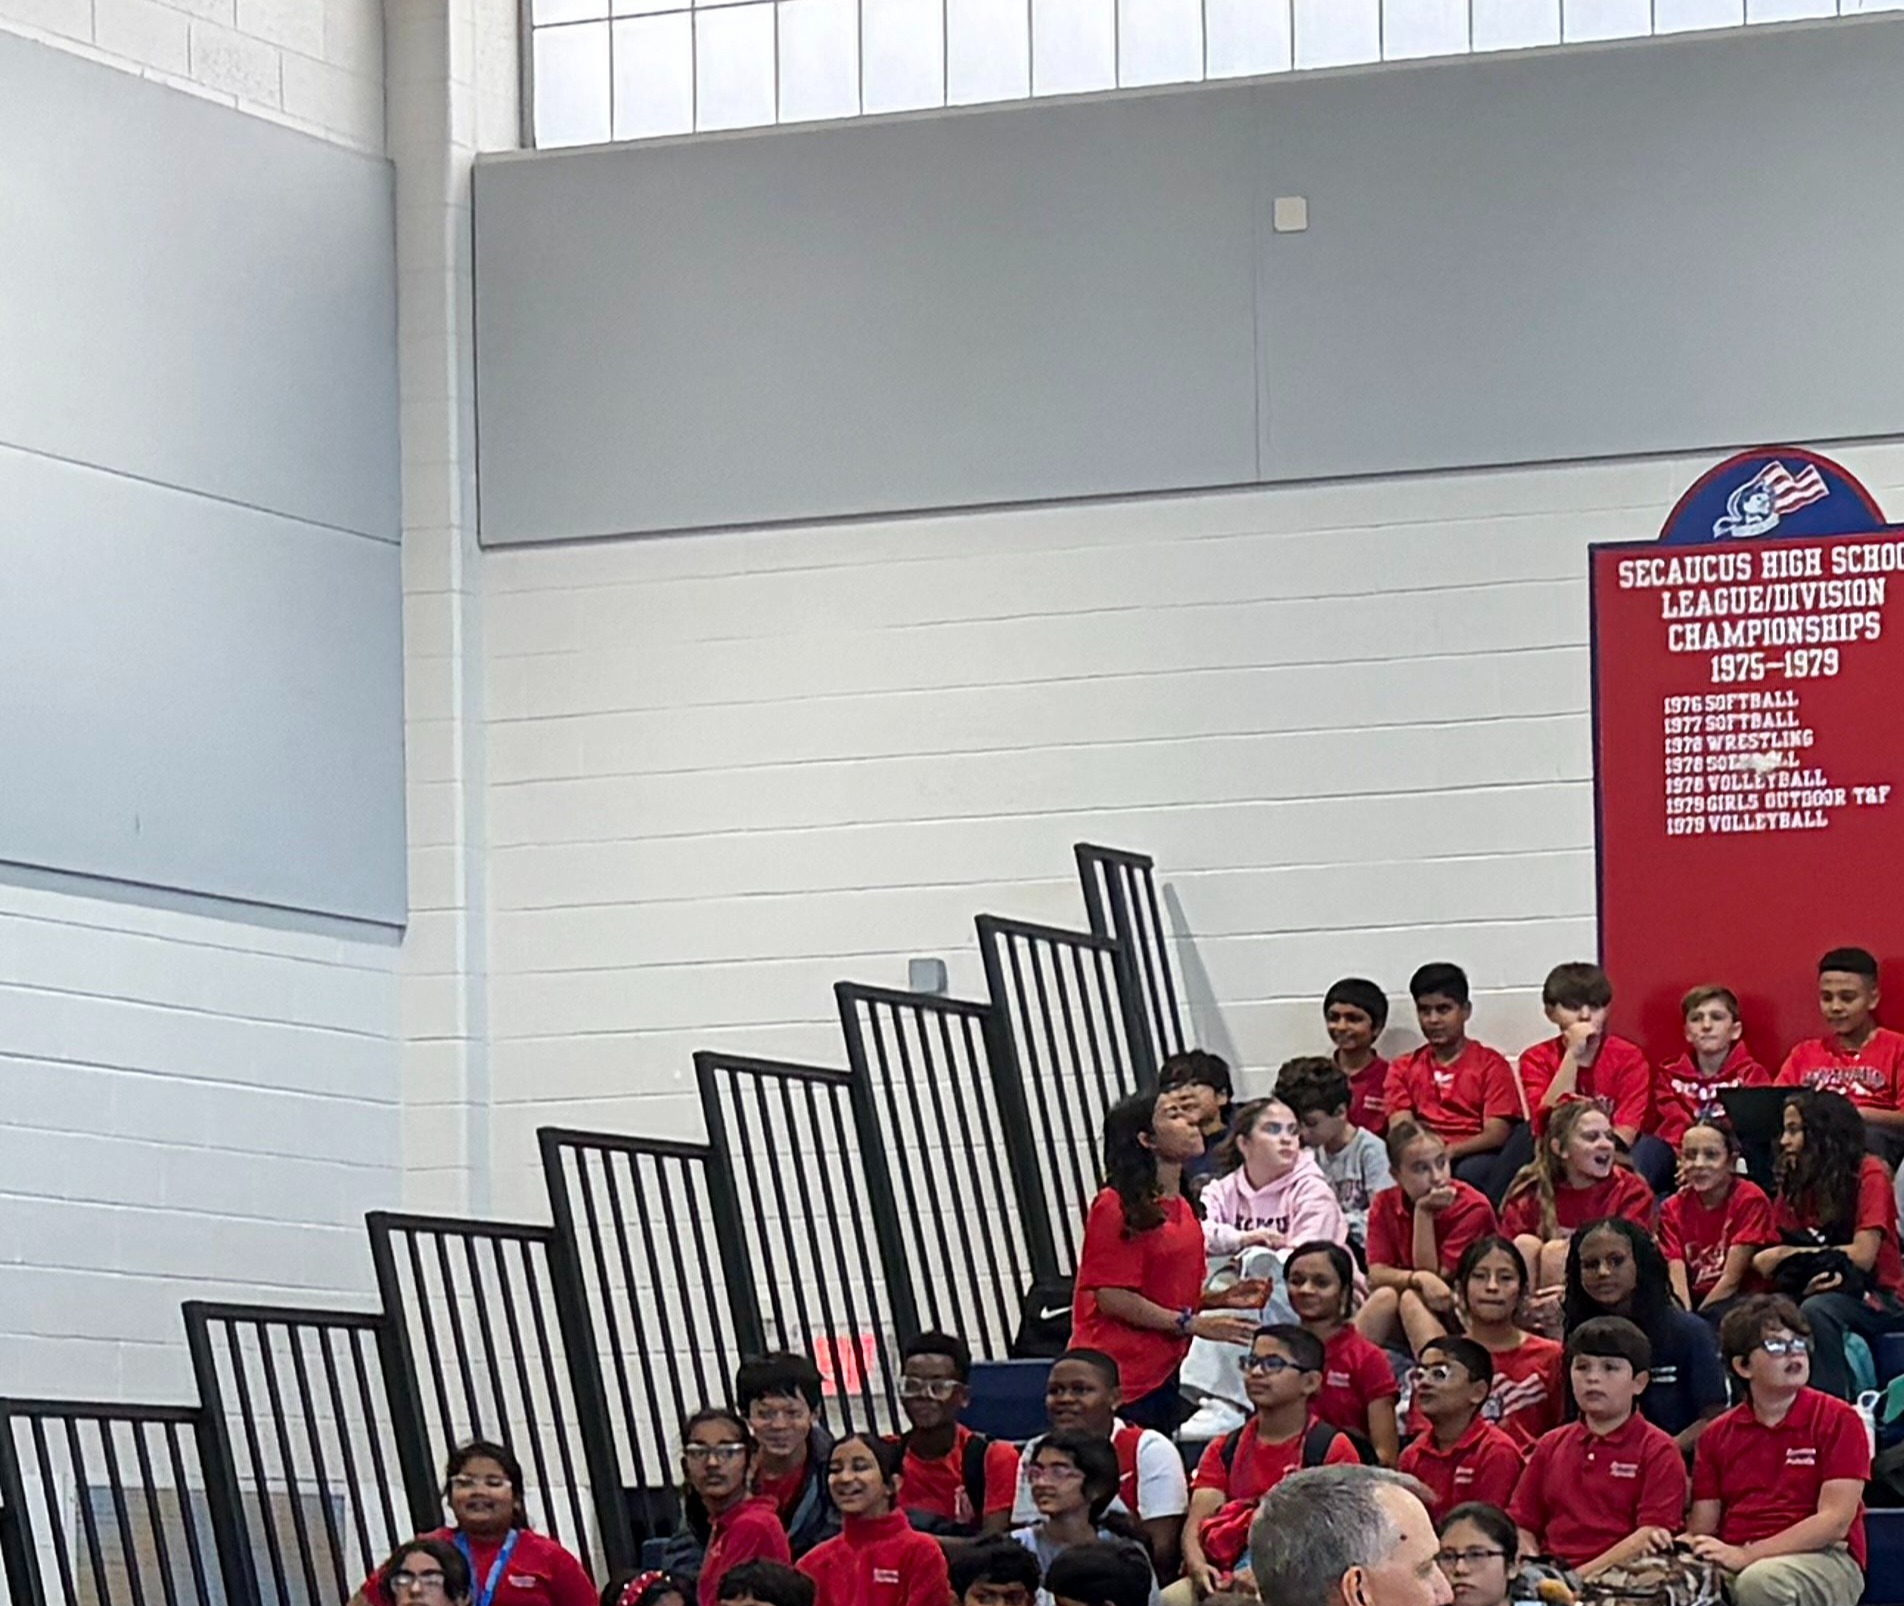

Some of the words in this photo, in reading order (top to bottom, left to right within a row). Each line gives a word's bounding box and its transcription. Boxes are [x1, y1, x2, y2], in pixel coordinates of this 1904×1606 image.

[1618, 552, 1752, 589] SECAUCUS
[1760, 547, 1823, 580] HIGH
[1661, 576, 1886, 620] LEAGUE/DIVISION
[1668, 611, 1881, 652] CHAMPIONSHIPS
